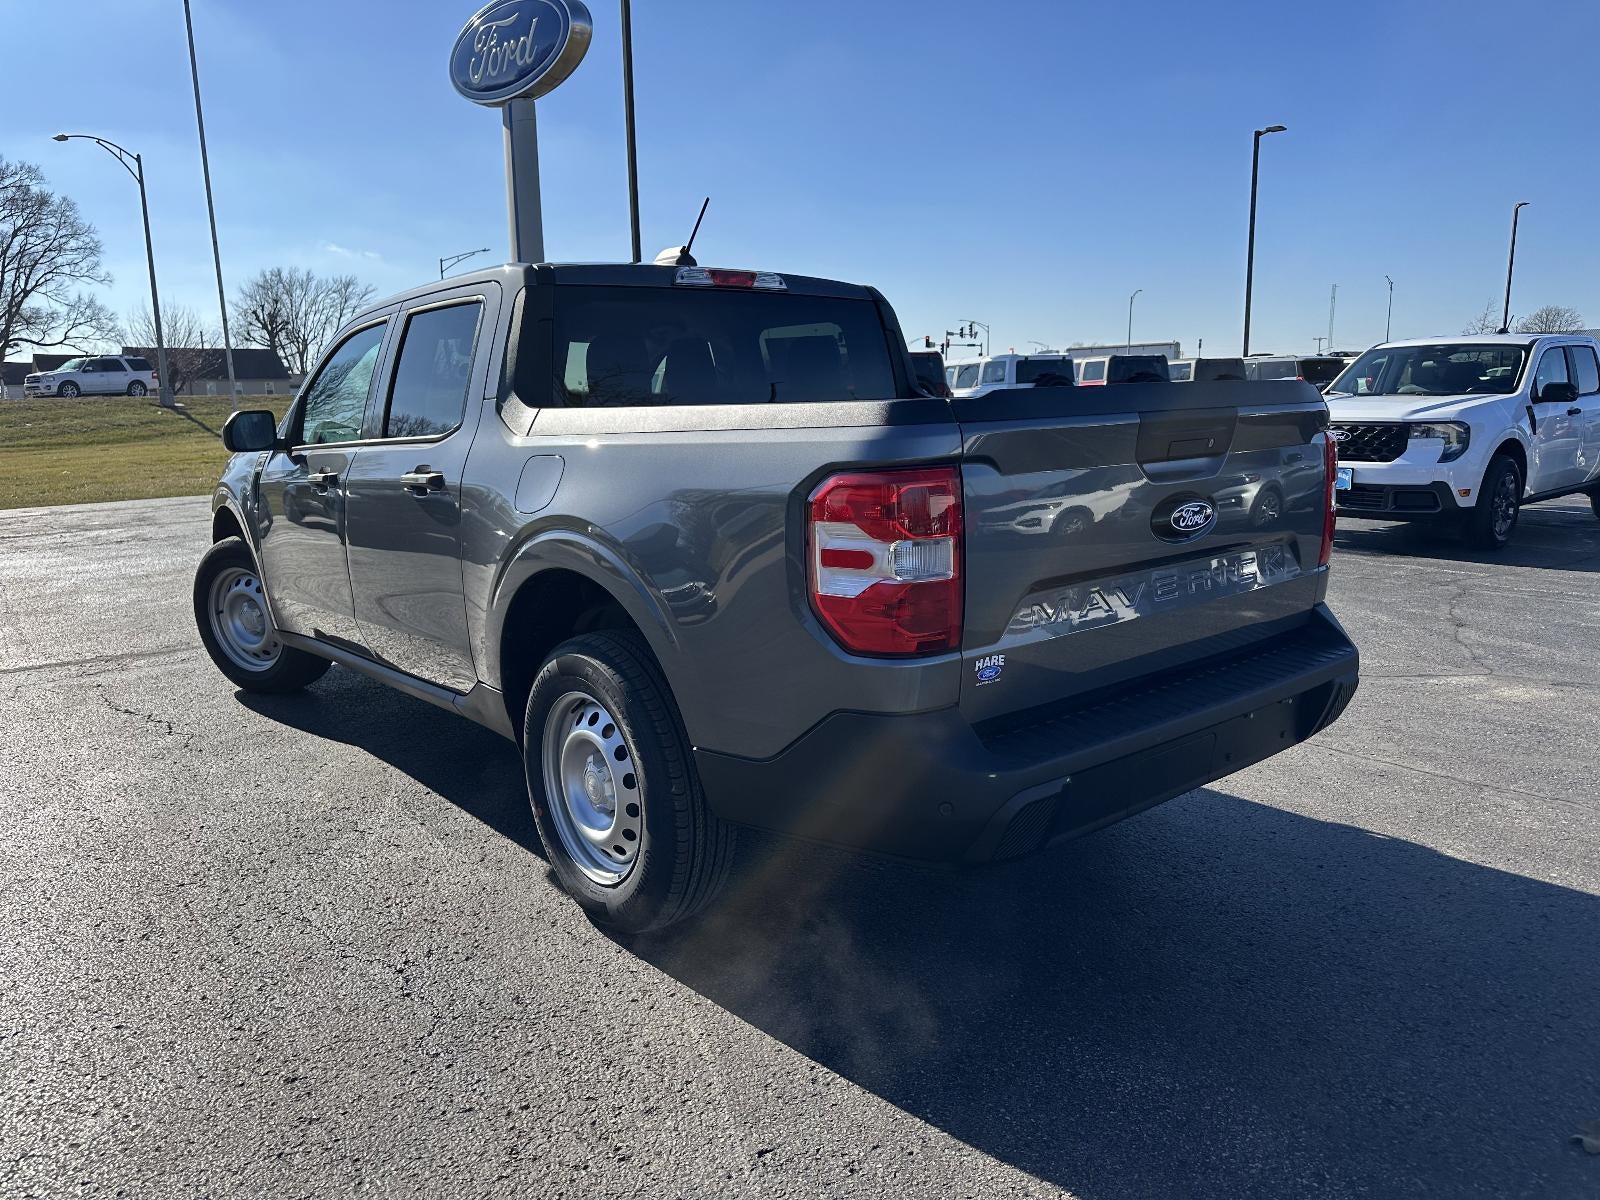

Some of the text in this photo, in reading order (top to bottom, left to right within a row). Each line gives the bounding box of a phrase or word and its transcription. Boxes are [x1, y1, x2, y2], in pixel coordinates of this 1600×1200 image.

[469, 12, 539, 84] Ford
[1180, 506, 1206, 527] Ford
[1030, 546, 1286, 627] MAVERICK
[974, 654, 1005, 672] HARE
